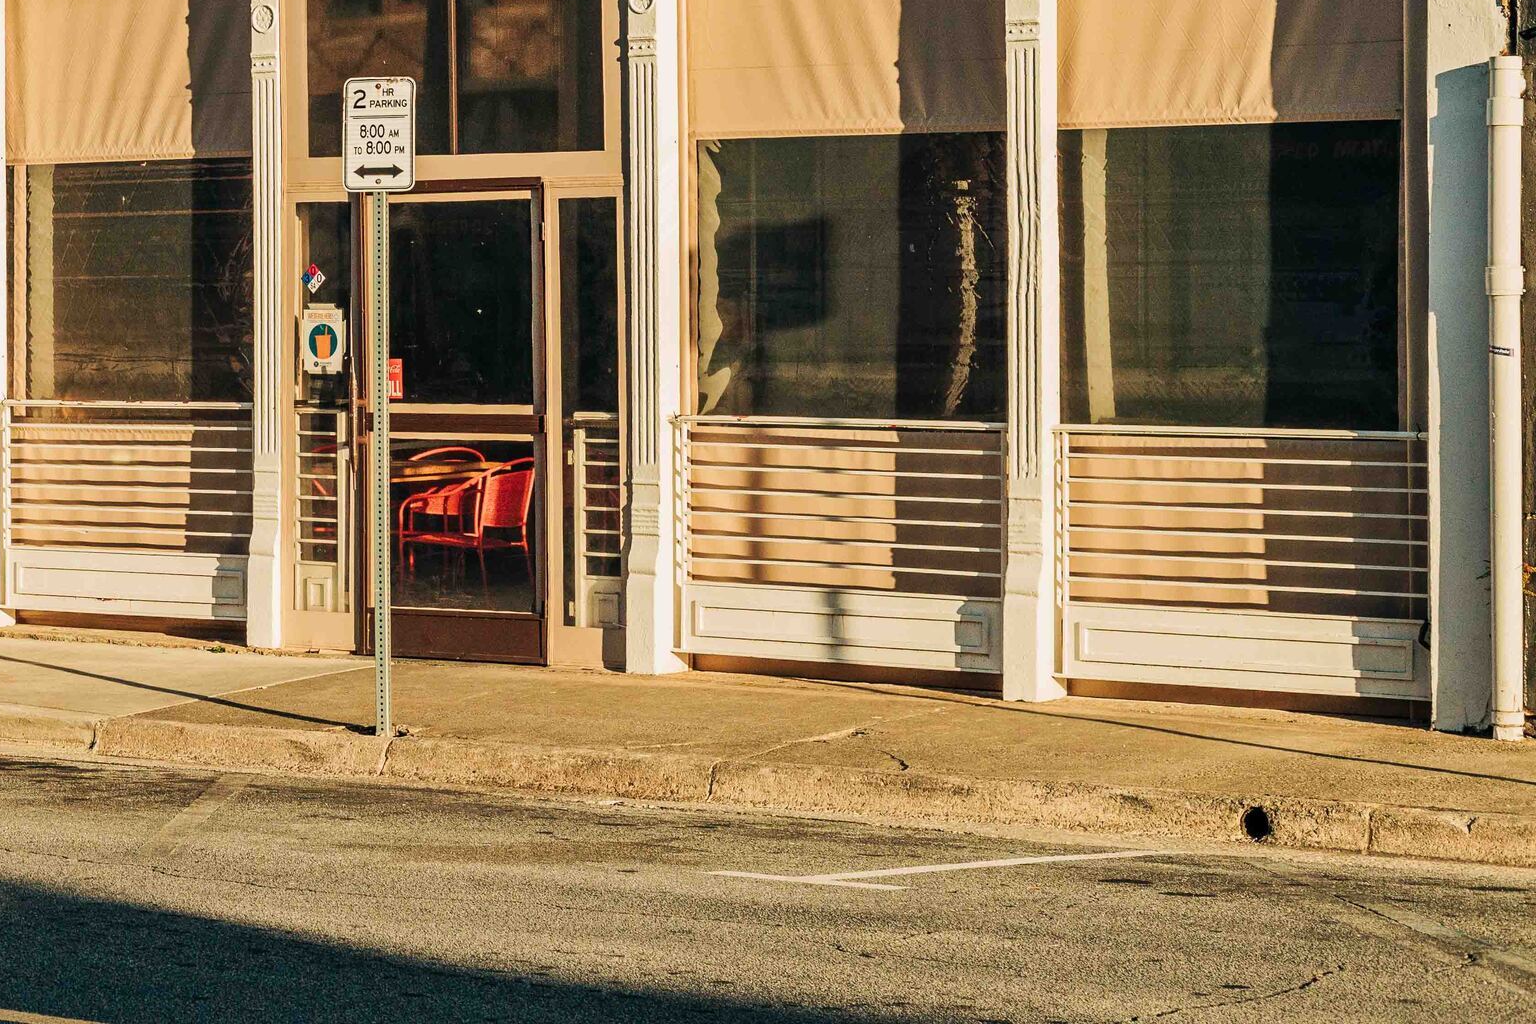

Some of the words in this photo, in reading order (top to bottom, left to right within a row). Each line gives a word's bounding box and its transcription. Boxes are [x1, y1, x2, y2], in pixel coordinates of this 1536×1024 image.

[352, 89, 366, 109] 2
[382, 88, 395, 97] HR
[369, 99, 408, 108] PARKING
[359, 124, 385, 138] 8:00
[388, 129, 399, 138] AM
[353, 146, 362, 155] TO
[366, 140, 392, 155] 8:00
[394, 145, 405, 154] PM
